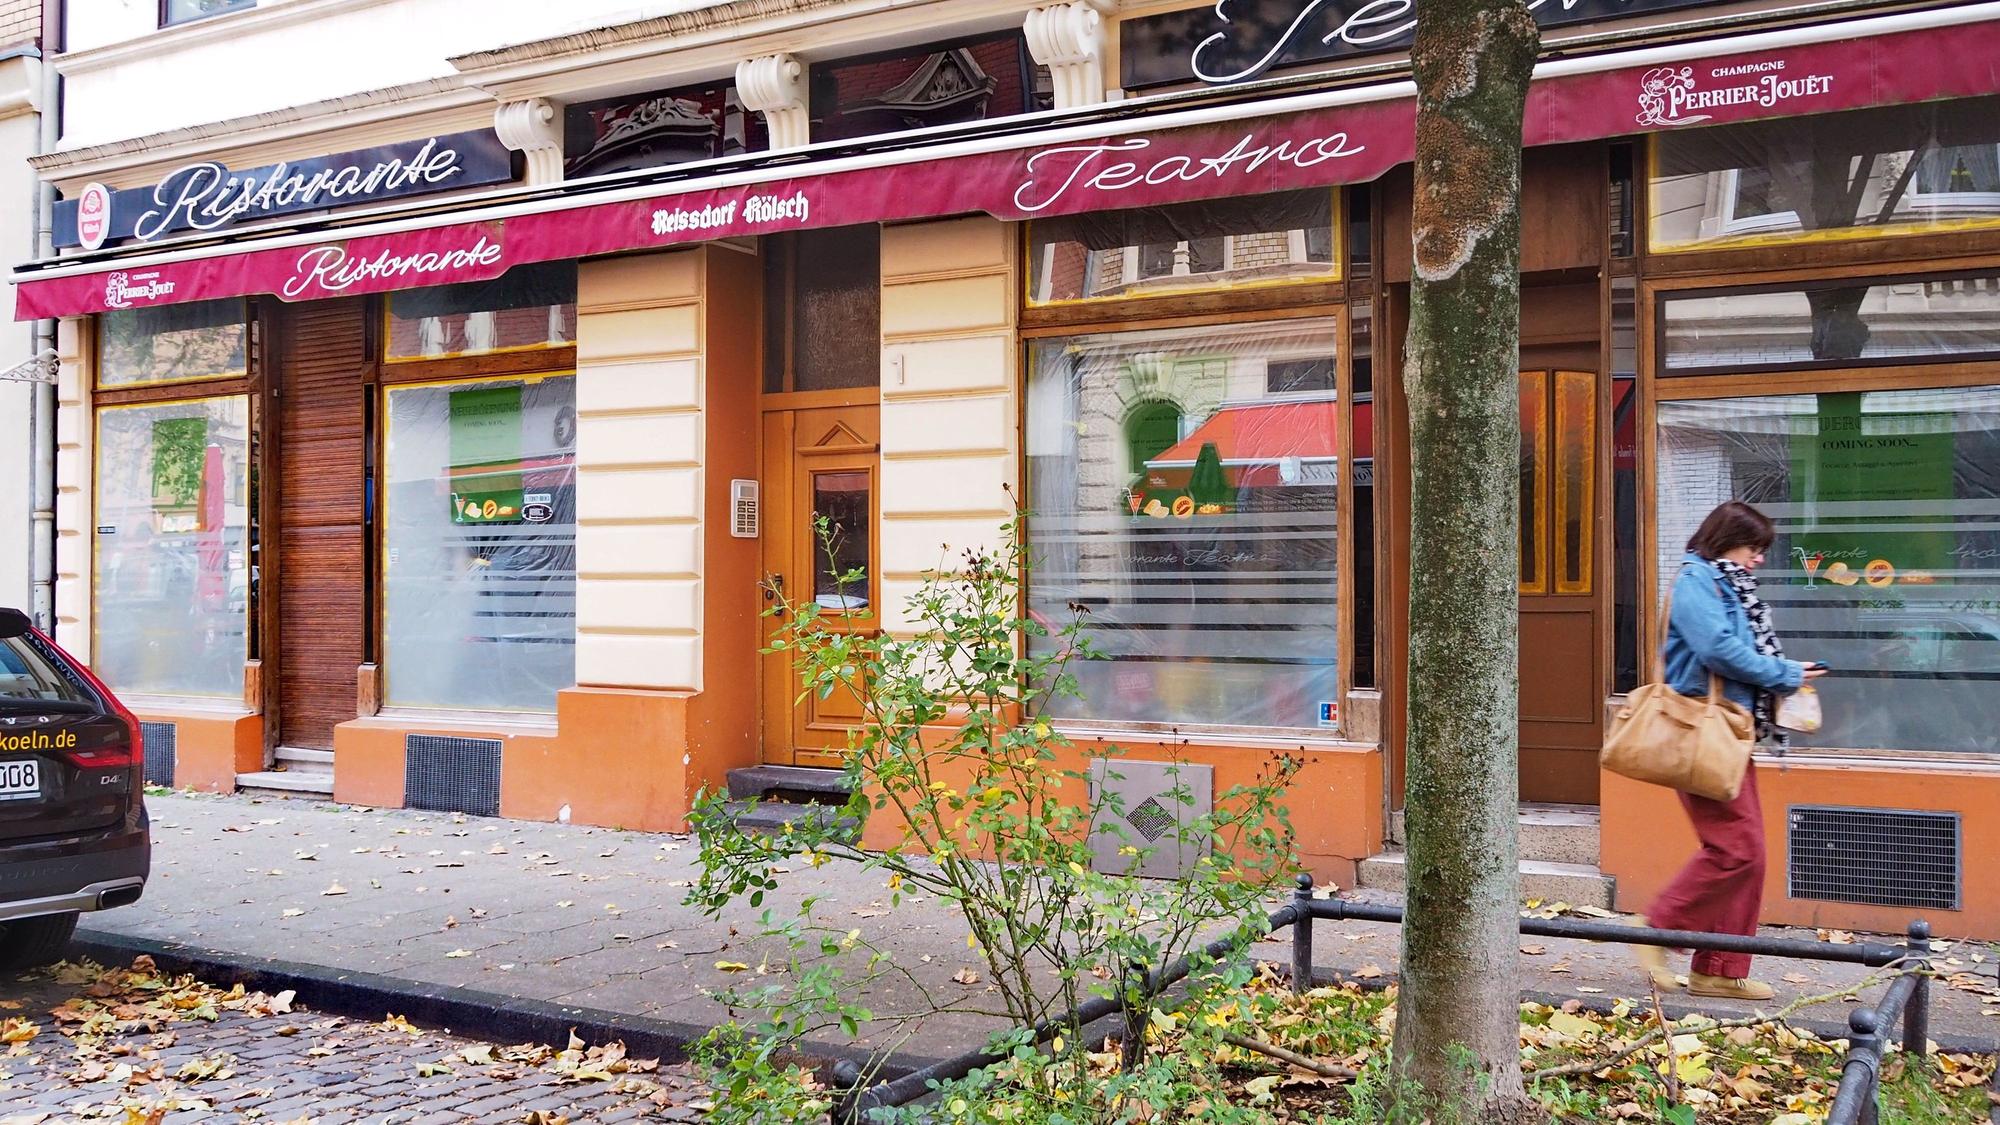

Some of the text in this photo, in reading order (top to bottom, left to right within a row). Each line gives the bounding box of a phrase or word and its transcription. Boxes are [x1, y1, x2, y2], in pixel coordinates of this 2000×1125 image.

[1711, 60, 1785, 78] CHAMPAGNE
[134, 137, 461, 241] Ristorante
[1014, 133, 1366, 212] Teatro
[651, 190, 809, 235] Reissdorf Kölsch
[283, 236, 502, 297] Ristorante
[1822, 439, 1873, 450] COMING
